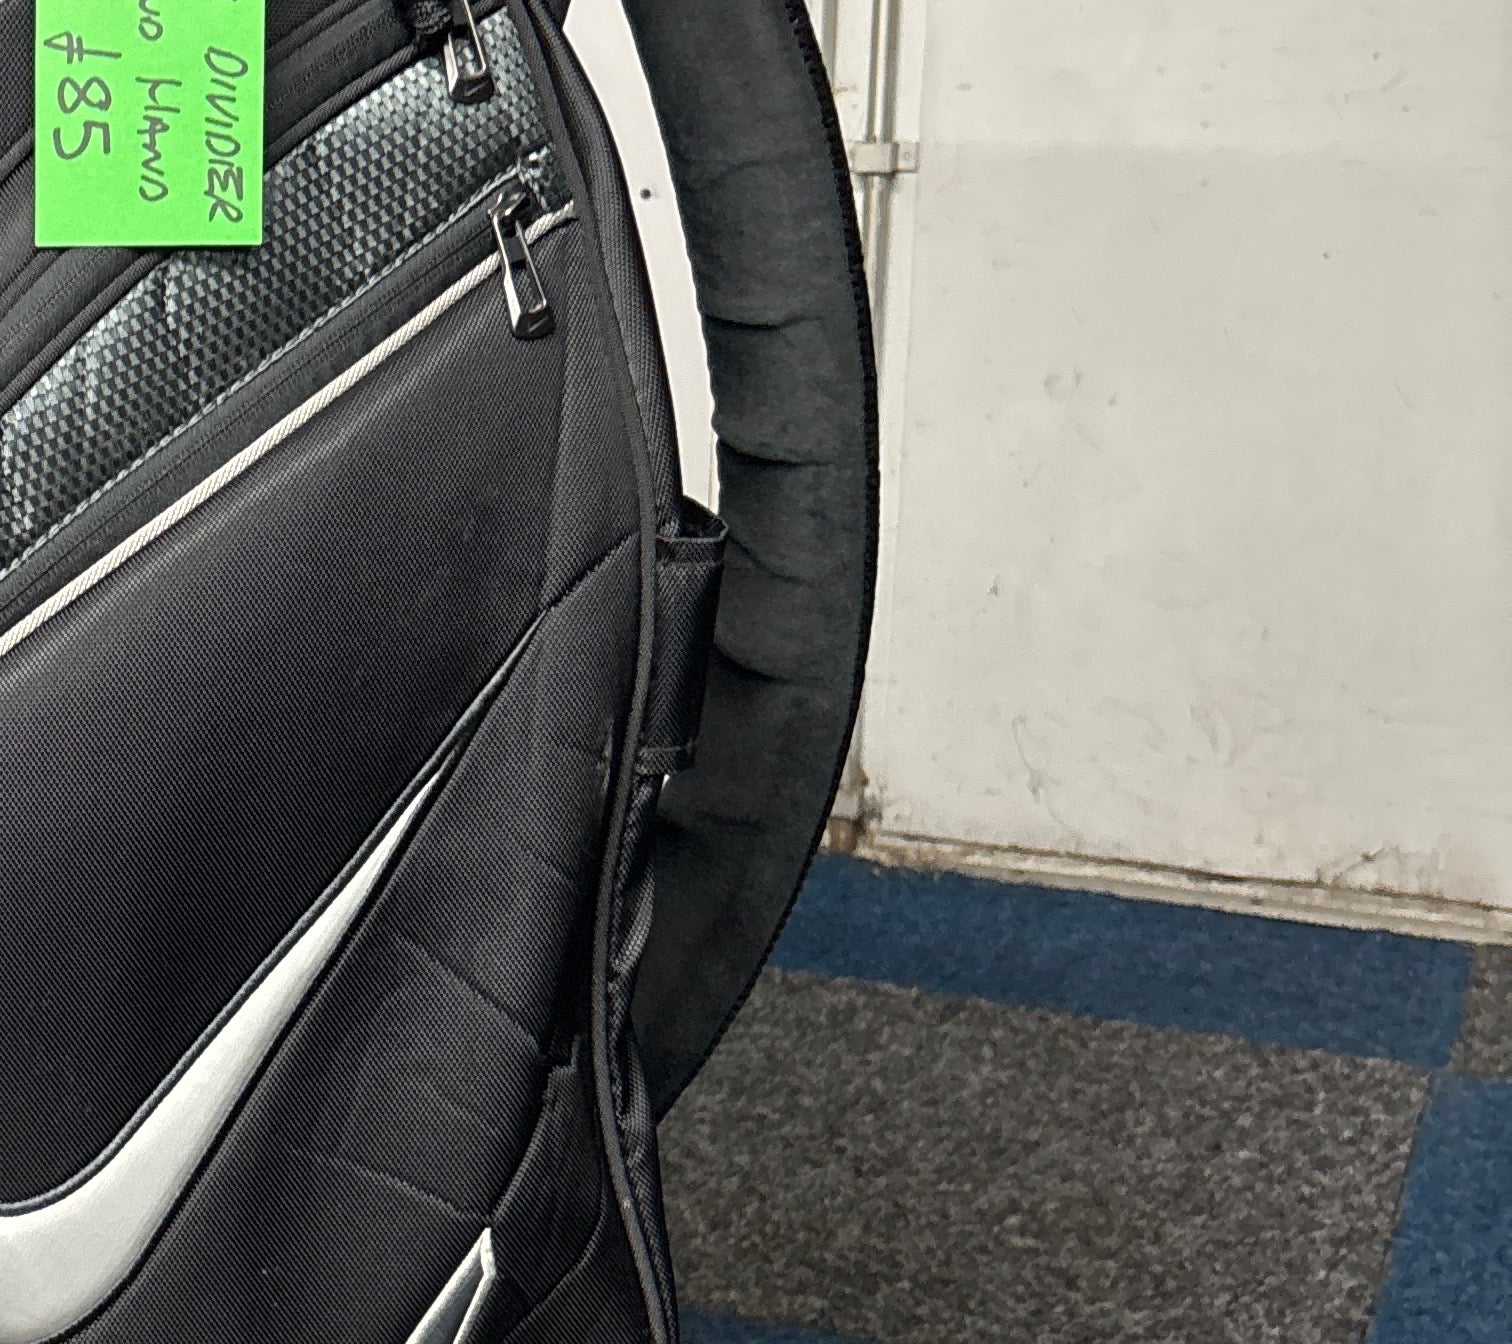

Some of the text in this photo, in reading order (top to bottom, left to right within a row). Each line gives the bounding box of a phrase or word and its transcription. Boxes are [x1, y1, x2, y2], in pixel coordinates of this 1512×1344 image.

[43, 30, 123, 160] £85
[135, 76, 183, 202] HAND
[203, 46, 249, 223] DIVIDER
